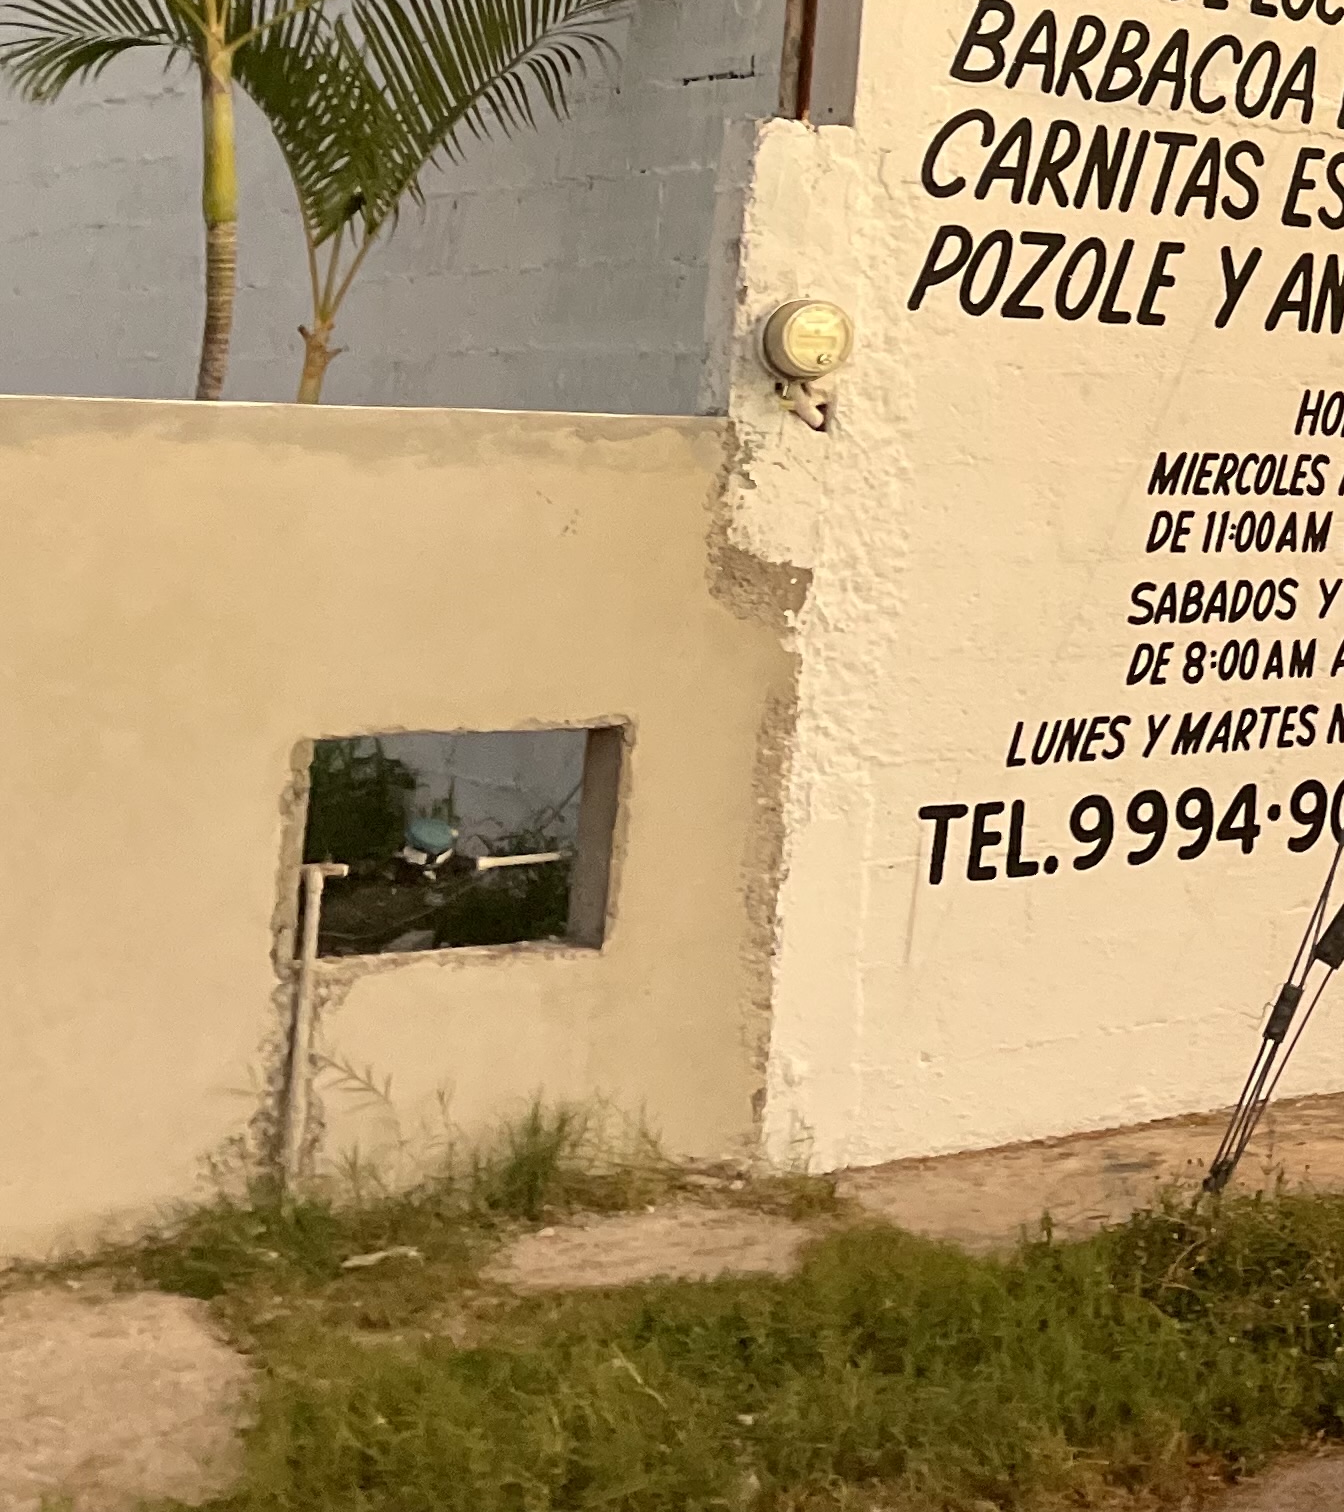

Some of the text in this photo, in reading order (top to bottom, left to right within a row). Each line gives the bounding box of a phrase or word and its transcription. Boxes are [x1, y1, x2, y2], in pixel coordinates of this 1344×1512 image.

[922, 109, 1264, 220] CARNITAS
[908, 225, 1185, 326] POZOLE
[1215, 246, 1262, 328] Y
[1148, 452, 1330, 496] MIERCOLES
[1146, 511, 1195, 553] DE
[1127, 578, 1299, 625] SABADOS
[1319, 579, 1343, 619] Y
[1126, 642, 1174, 685] DE
[1006, 716, 1131, 767] LUNES
[1143, 714, 1170, 757] Y
[1172, 705, 1318, 755] MARTES
